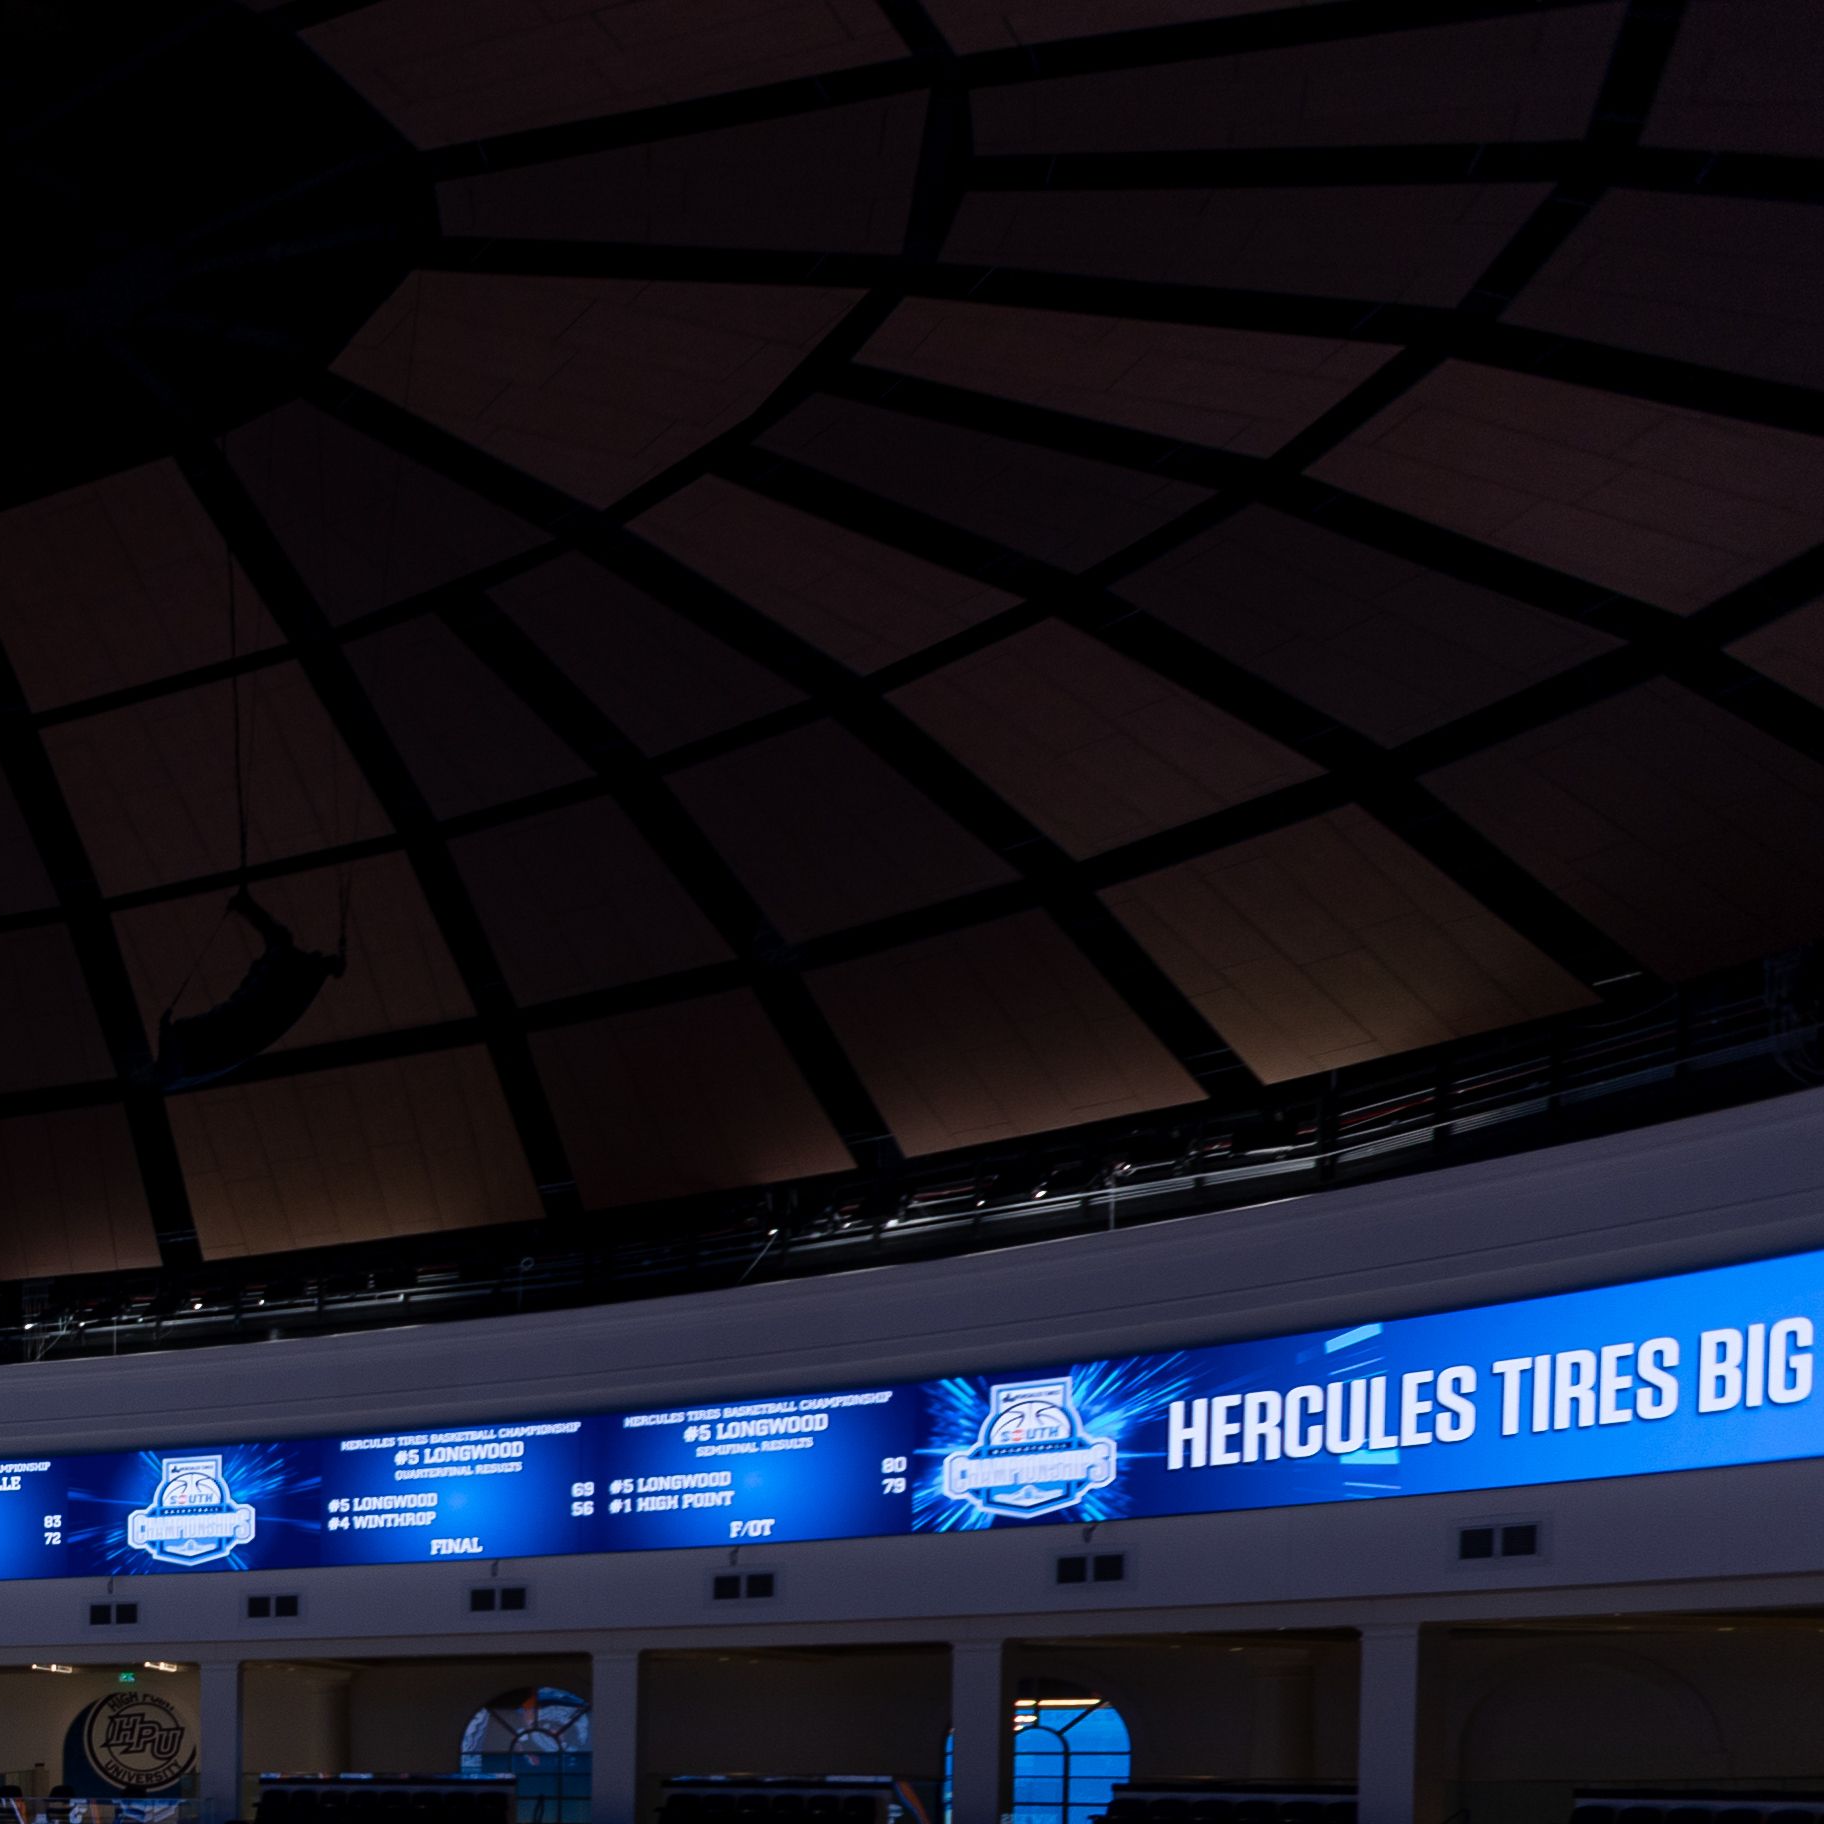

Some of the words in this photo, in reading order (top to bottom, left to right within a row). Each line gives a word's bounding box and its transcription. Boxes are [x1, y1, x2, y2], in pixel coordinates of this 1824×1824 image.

[1167, 1366, 1478, 1470] HERCULES
[1492, 1337, 1680, 1438] TIRES
[1698, 1317, 1815, 1415] BIG
[683, 1424, 711, 1443] #5
[716, 1413, 829, 1441] LONGWOOD
[394, 1448, 419, 1466] #5
[423, 1441, 524, 1464] LONGWOOD
[881, 1456, 907, 1474] 80
[609, 1479, 634, 1495] #5
[636, 1471, 732, 1493] LONGWOOD
[881, 1478, 906, 1494] 79
[353, 1493, 438, 1511] LONGWOOD
[636, 1494, 679, 1512] HIGH
[682, 1490, 735, 1509] POINT
[353, 1512, 436, 1529] WINTHROP
[728, 1519, 776, 1539] F/OT
[431, 1537, 483, 1555] FINAL
[101, 1712, 185, 1761] HPU
[104, 1759, 182, 1784] UNIVERSITY
